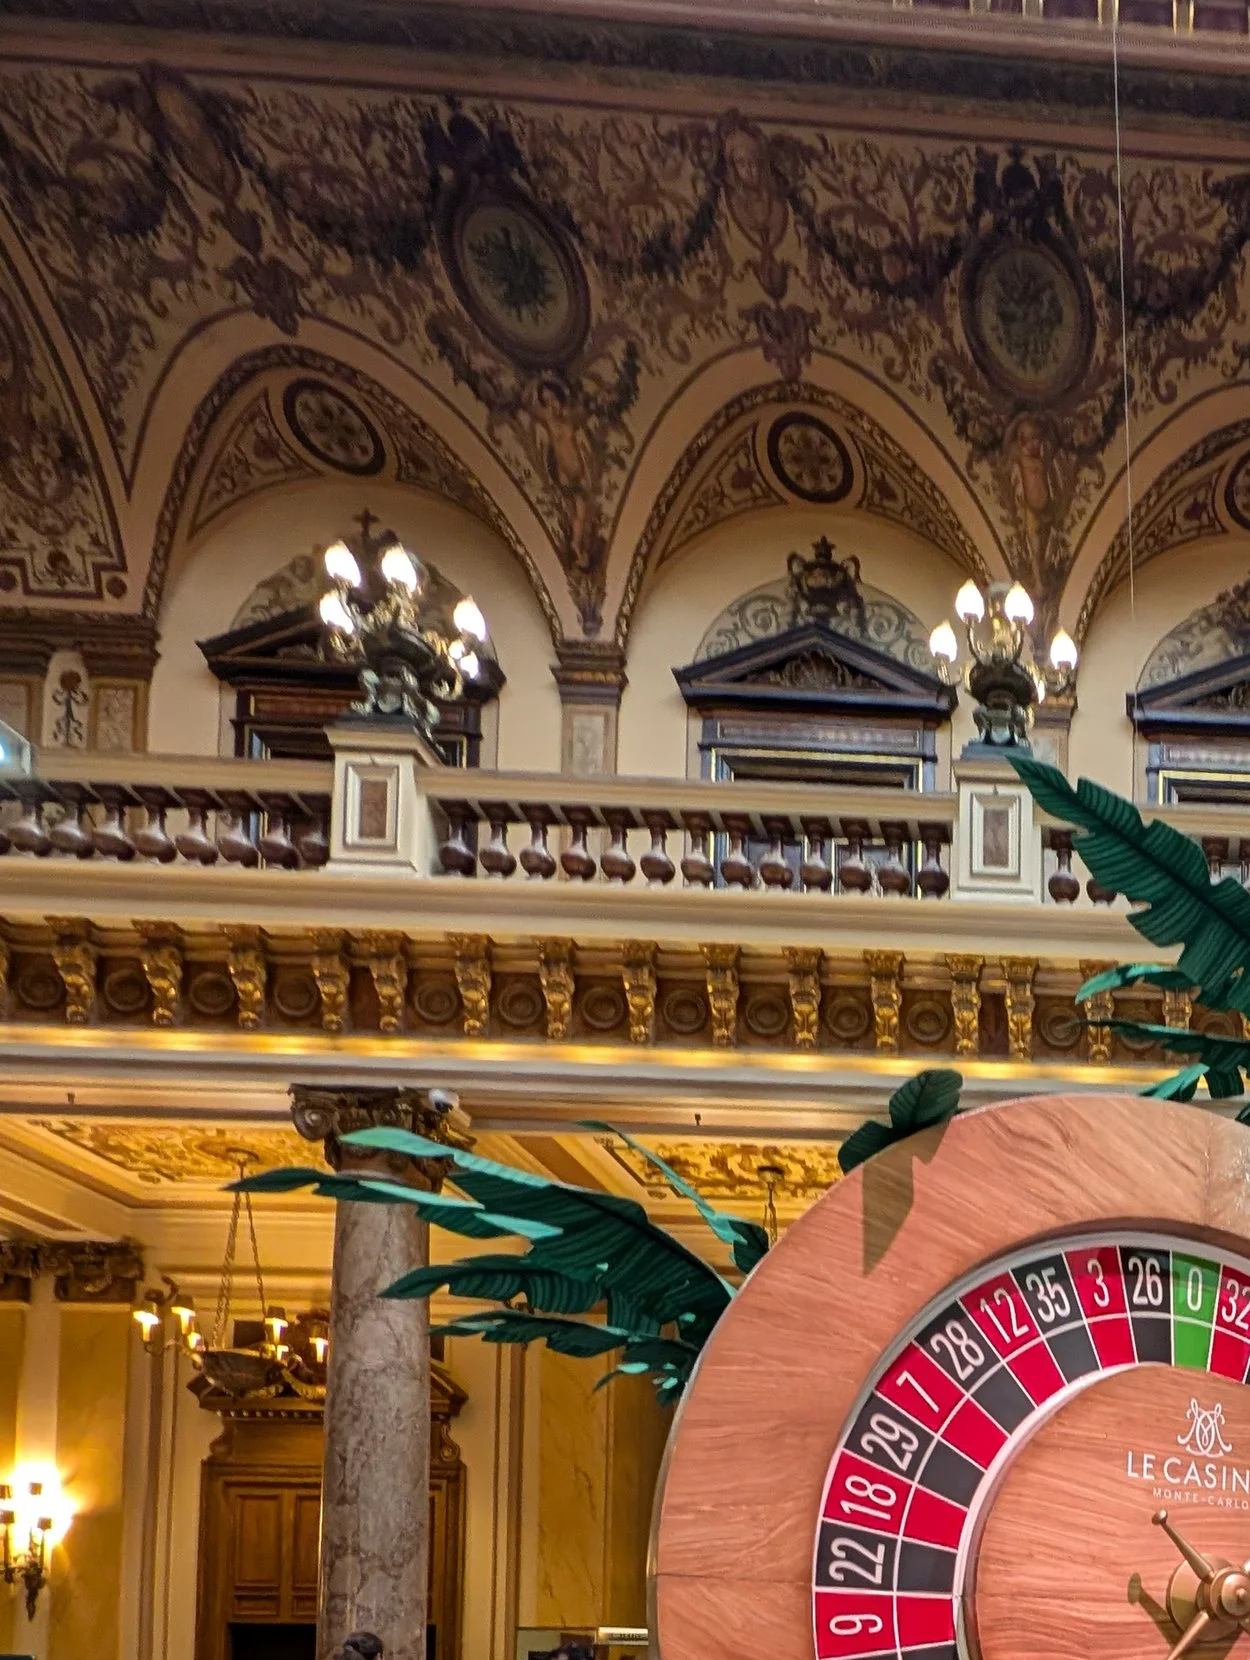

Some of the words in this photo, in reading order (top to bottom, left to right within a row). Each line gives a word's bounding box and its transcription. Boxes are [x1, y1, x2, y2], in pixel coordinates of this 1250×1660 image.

[1026, 1267, 1071, 1322] 35
[1088, 1258, 1110, 1307] 3
[1128, 1257, 1162, 1306] 26
[1187, 1267, 1202, 1311] 0
[980, 1288, 1029, 1343] 12
[931, 1321, 985, 1380] 28
[896, 1371, 940, 1412] 7
[861, 1413, 919, 1472] 29
[1127, 1451, 1156, 1480] LE
[840, 1475, 897, 1520] 18
[829, 1537, 886, 1584] 22
[829, 1613, 883, 1635] 9
